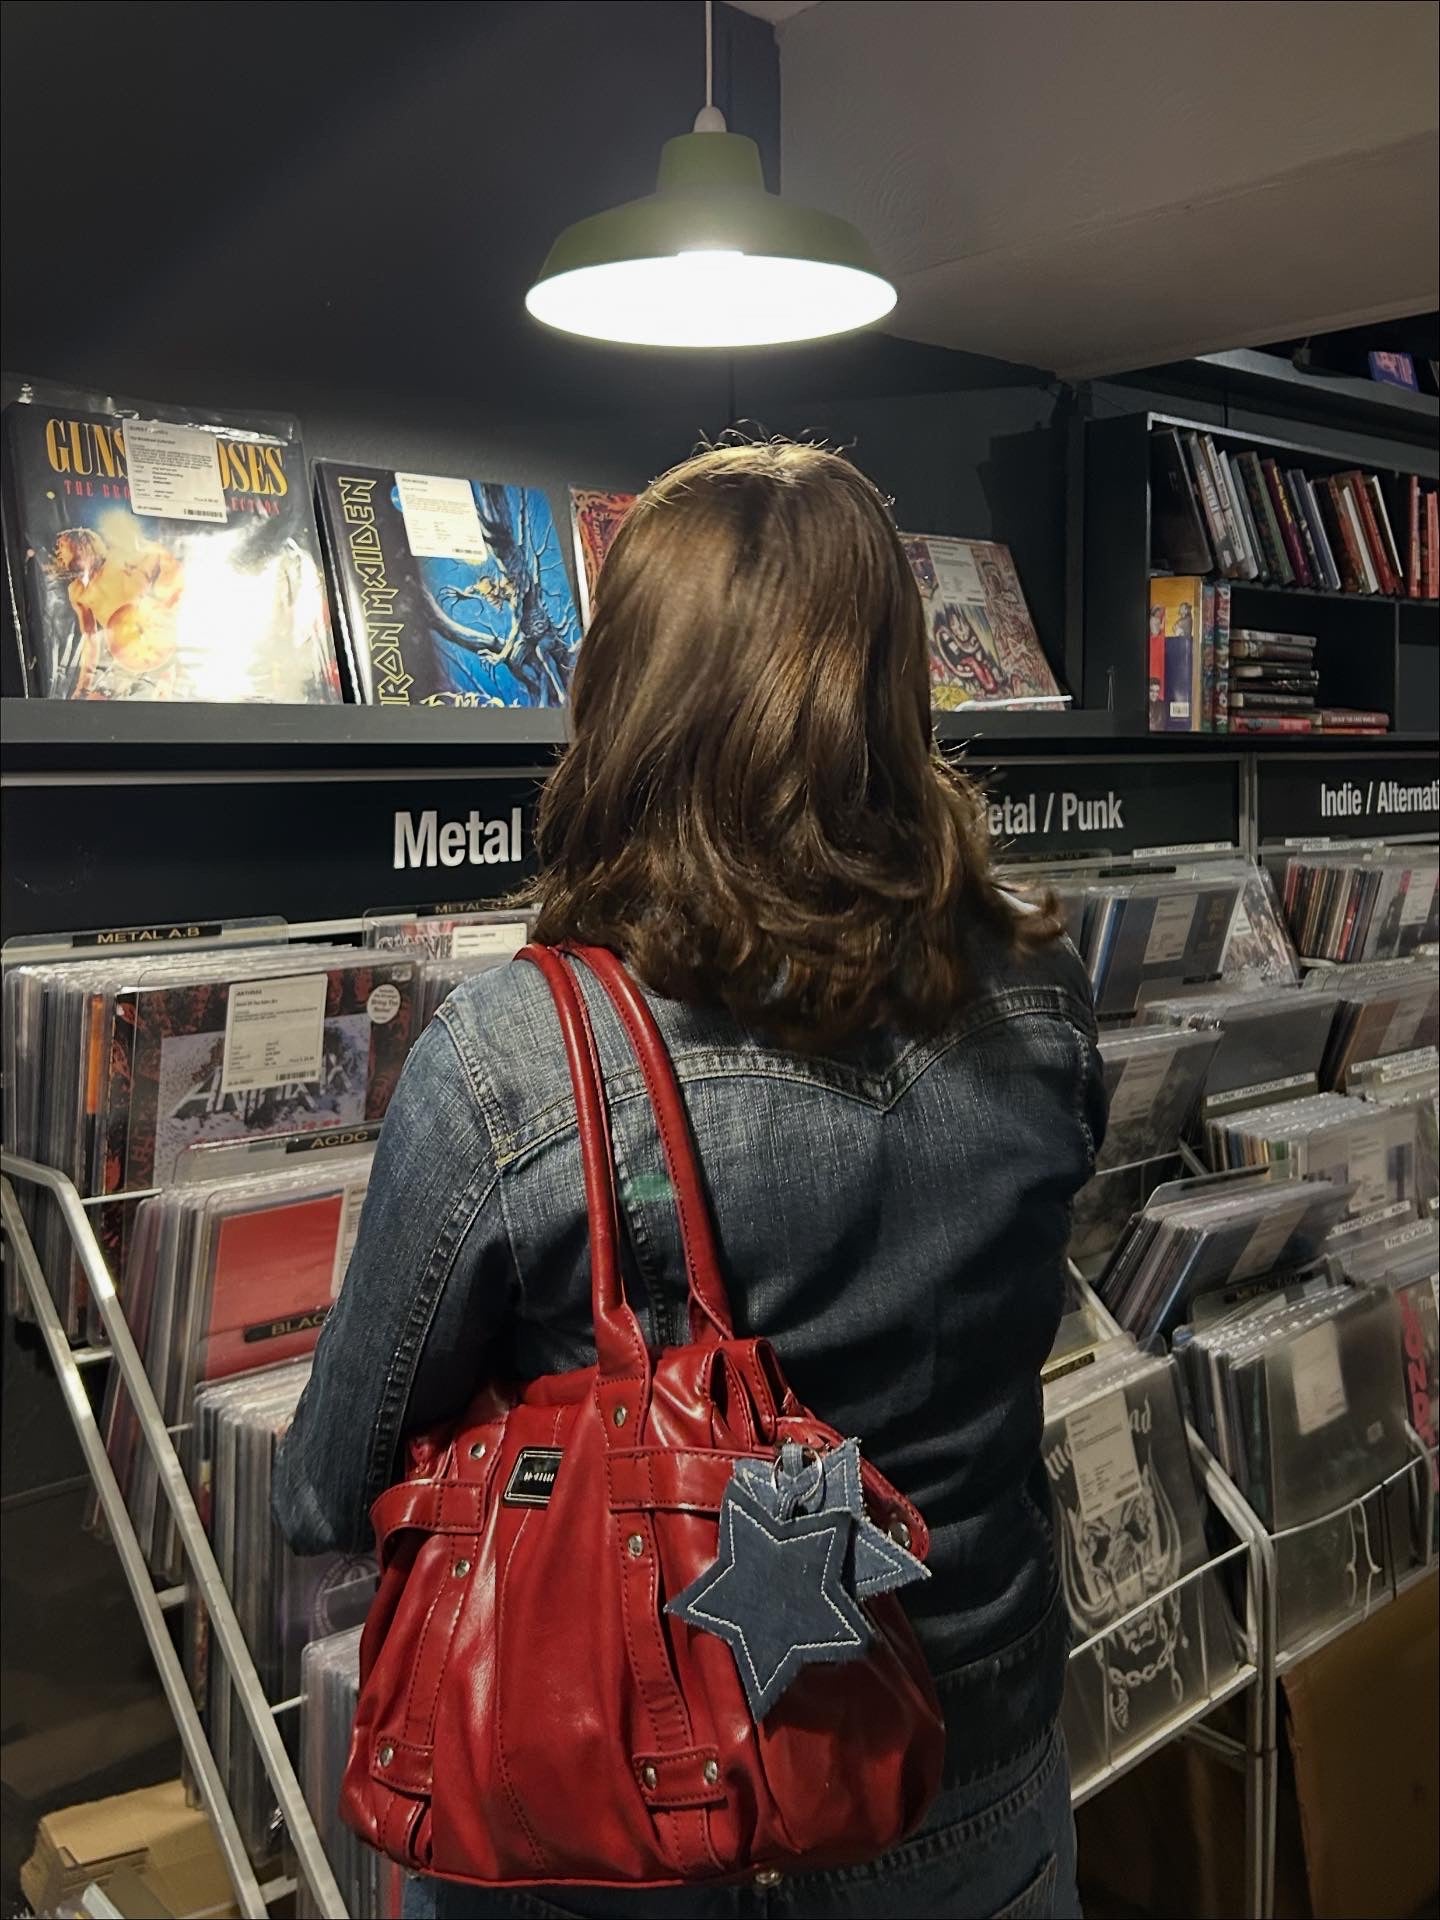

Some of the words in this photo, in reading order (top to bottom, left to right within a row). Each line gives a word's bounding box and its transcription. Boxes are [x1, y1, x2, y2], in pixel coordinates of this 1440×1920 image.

[338, 476, 399, 616] MAIDEN
[988, 793, 1036, 836] etal
[1043, 792, 1055, 833] /
[1062, 791, 1124, 832] Punk
[1321, 781, 1362, 817] Indie
[1366, 781, 1373, 815] /
[393, 807, 522, 869] Metal
[97, 931, 163, 944] METAL
[310, 1131, 368, 1149] ACDC
[271, 1314, 326, 1336] BLAC
